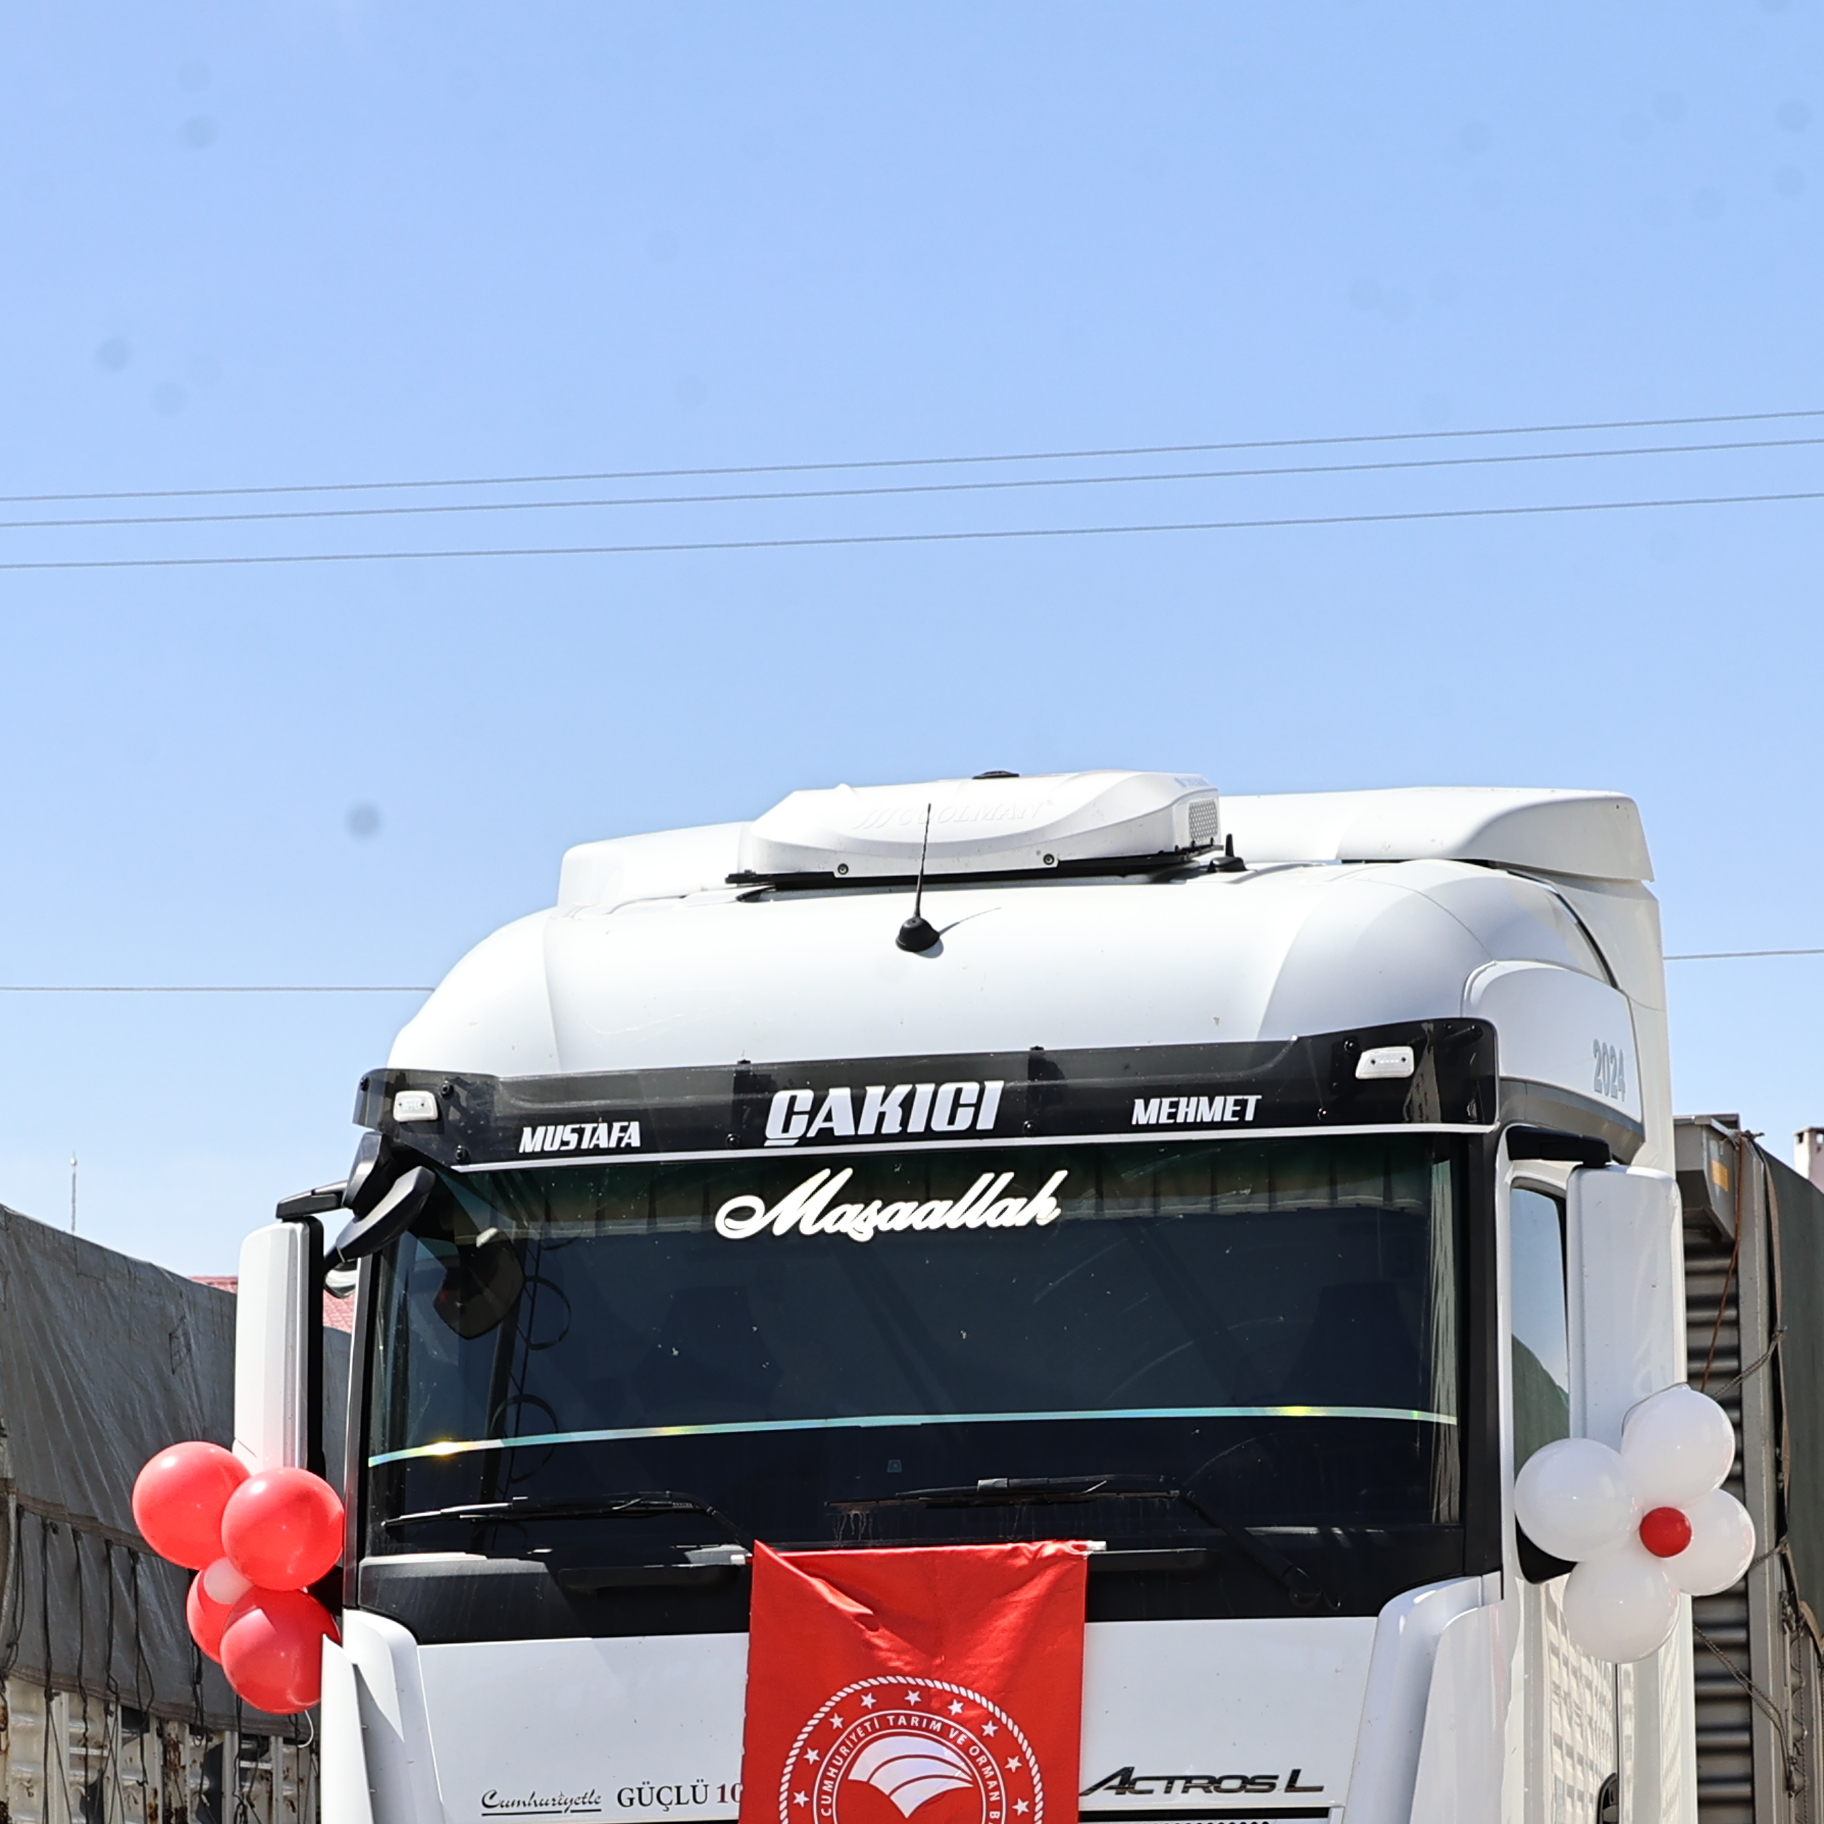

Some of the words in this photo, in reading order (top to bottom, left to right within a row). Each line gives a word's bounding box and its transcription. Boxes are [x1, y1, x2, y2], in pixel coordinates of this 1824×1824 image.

[1592, 1039, 1625, 1102] 2024
[1131, 1095, 1262, 1126] MEHMET
[518, 1121, 641, 1154] MUSTAFA
[821, 1717, 880, 1817] CUMHURİYETİ
[887, 1715, 942, 1732] TARIM
[948, 1727, 967, 1745] VE
[969, 1745, 1001, 1802] ORMAN
[1284, 1769, 1324, 1793] L
[617, 1779, 709, 1812] GÜÇLÜ
